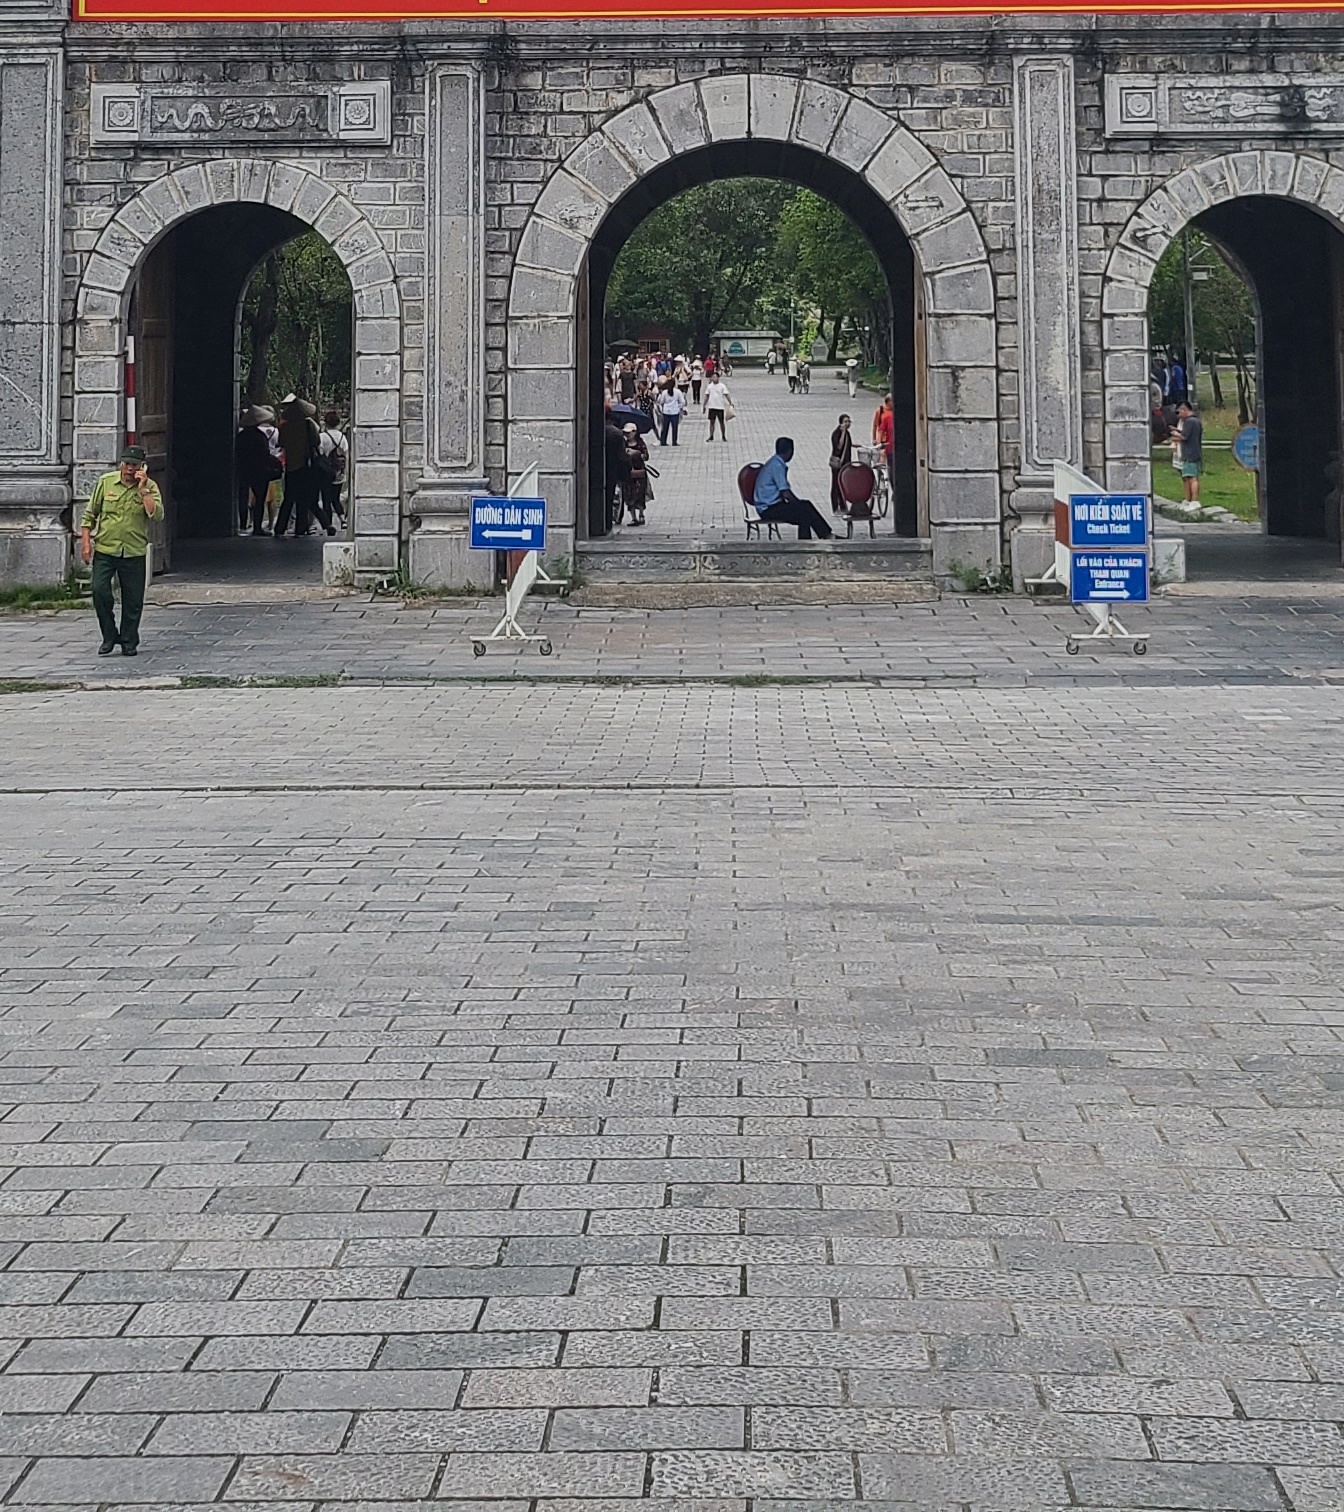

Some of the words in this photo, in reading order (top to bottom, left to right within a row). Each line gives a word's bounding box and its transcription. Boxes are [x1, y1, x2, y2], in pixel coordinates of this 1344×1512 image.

[475, 503, 503, 525] ĐƯỜNG
[523, 508, 543, 526] SINH
[1089, 499, 1110, 521] KIỂM
[1110, 501, 1131, 521] SOÁT
[1131, 501, 1143, 521] VÉ
[1087, 523, 1109, 534] Check
[1109, 523, 1131, 534] Ticket
[1089, 569, 1110, 579] THAM
[1110, 569, 1130, 580] QUAN
[1094, 579, 1125, 589] Entrance
